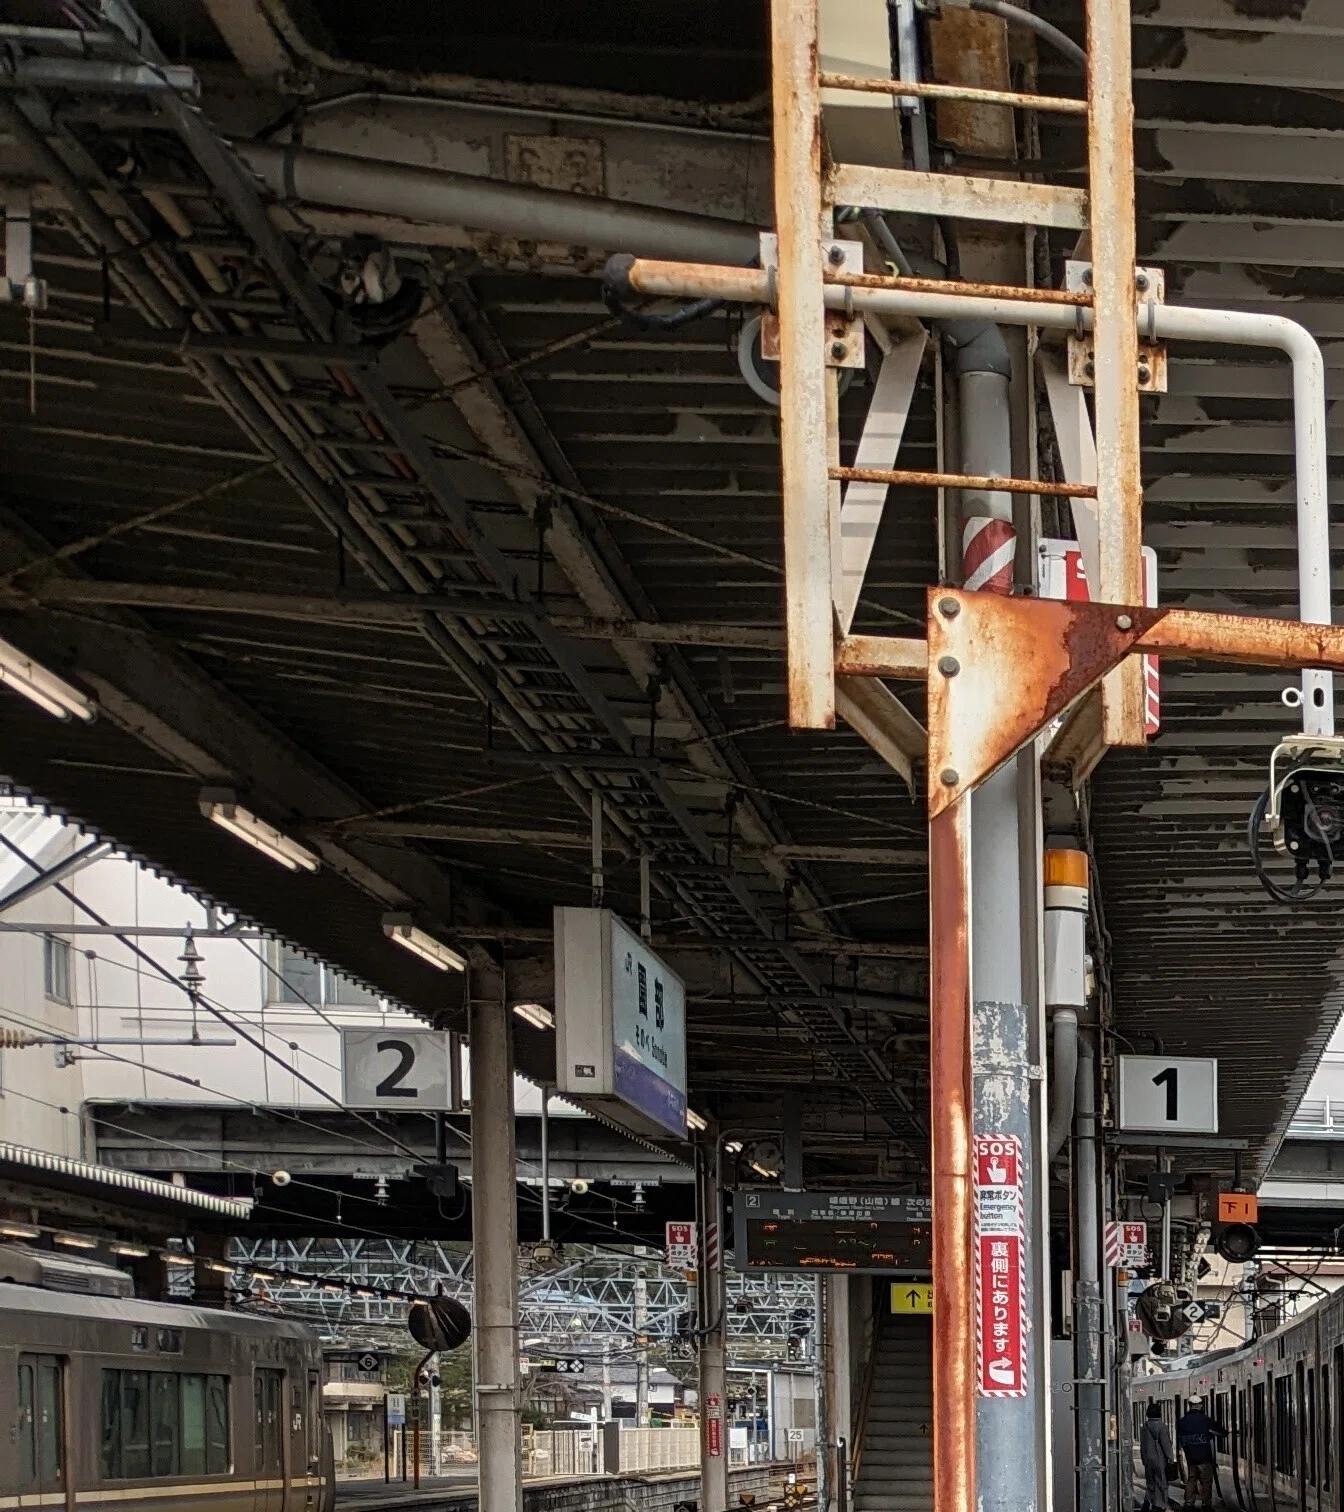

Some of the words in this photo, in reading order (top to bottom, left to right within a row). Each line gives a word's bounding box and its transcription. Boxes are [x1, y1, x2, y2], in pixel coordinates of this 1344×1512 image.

[637, 961, 665, 1033] 園部
[375, 1039, 419, 1098] 2
[1151, 1067, 1179, 1121] 1
[979, 1141, 1016, 1156] SOS
[748, 1196, 758, 1205] 2
[979, 1189, 1017, 1201] 非常ボタン
[979, 1203, 1017, 1213] Emergency
[979, 1211, 1004, 1220] button
[990, 1241, 1010, 1353] 裏側にあります
[1189, 1306, 1199, 1319] 2
[364, 1357, 373, 1368] 6
[789, 1430, 802, 1440] 25
